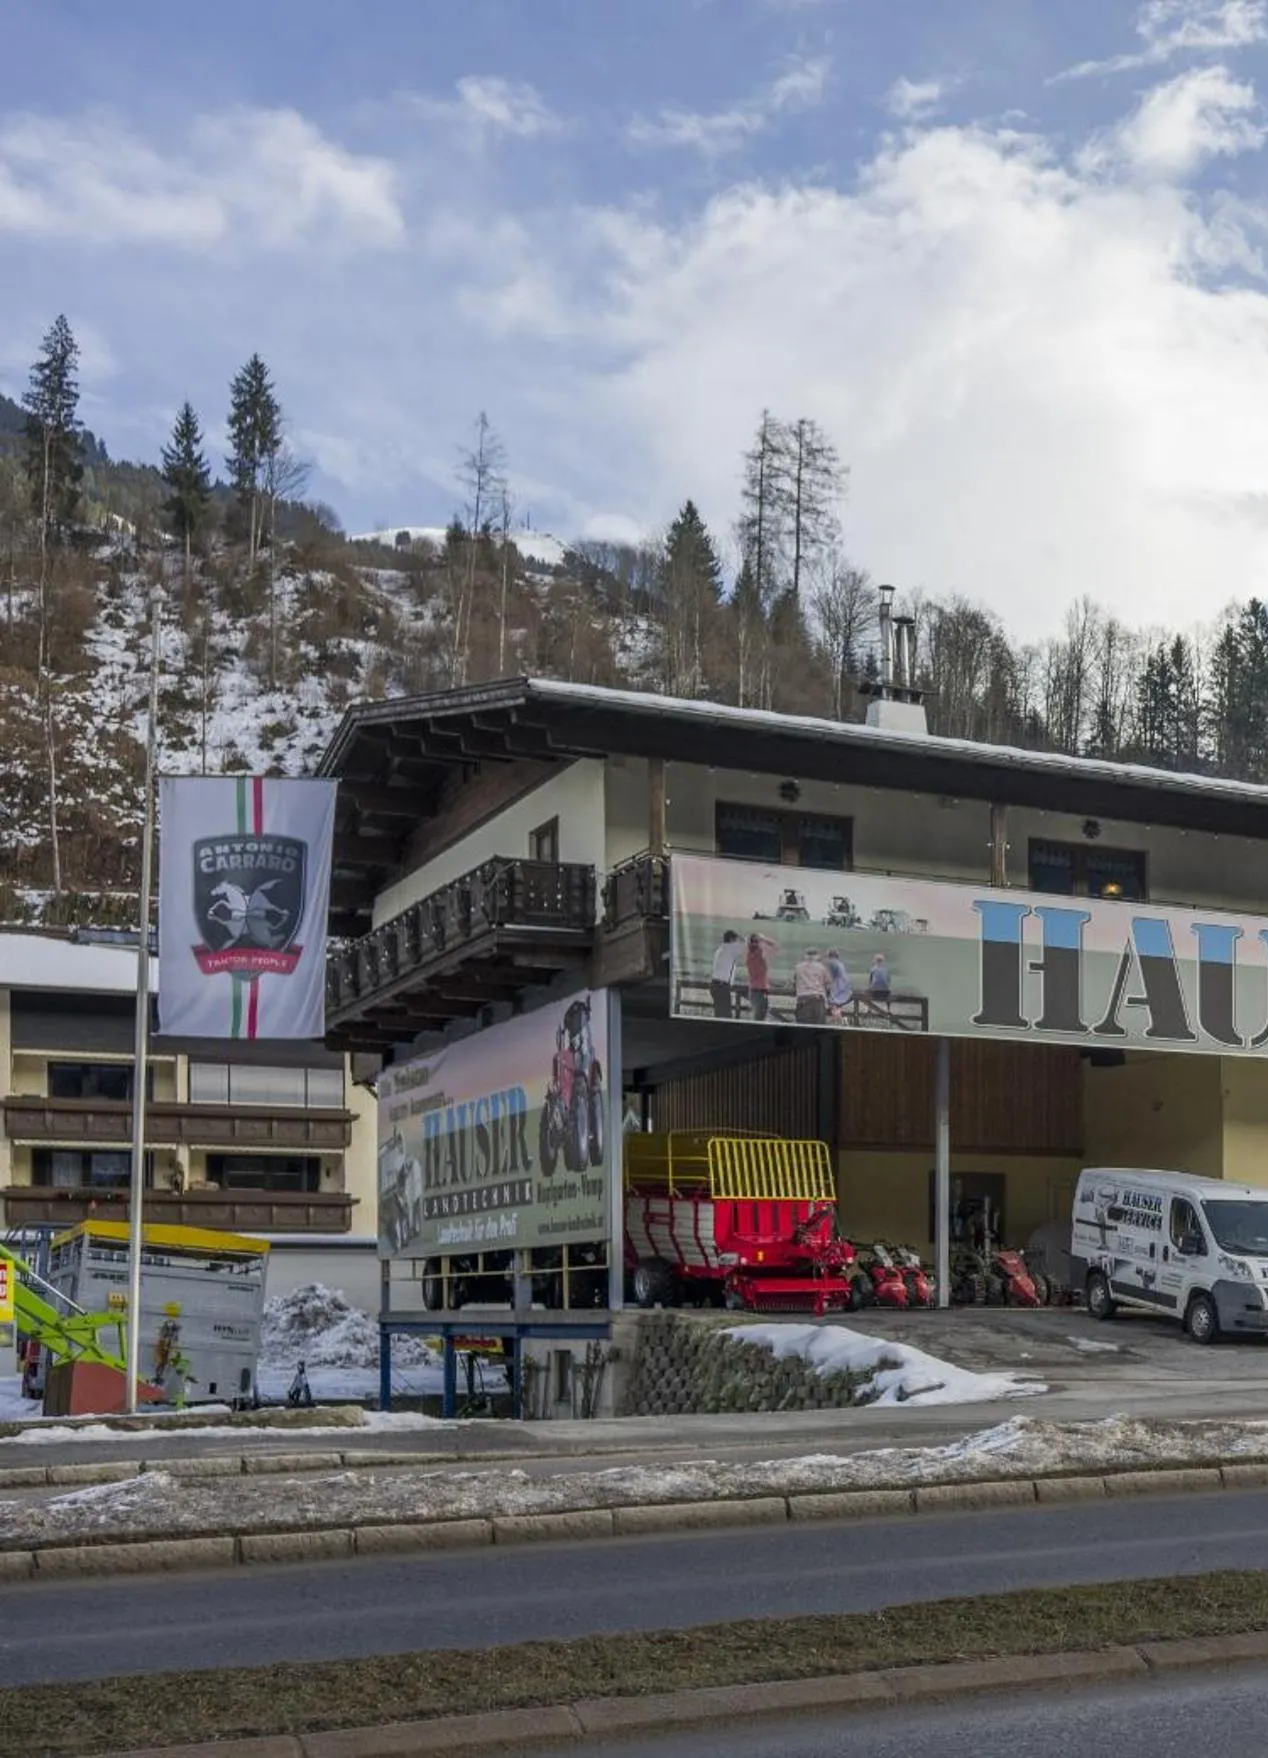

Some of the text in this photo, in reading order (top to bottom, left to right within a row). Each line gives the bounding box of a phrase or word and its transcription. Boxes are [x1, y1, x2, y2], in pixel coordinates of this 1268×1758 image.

[199, 842, 299, 858] ANTONIO
[200, 853, 296, 873] CARRARO
[422, 1083, 534, 1190] HAUSER
[422, 1179, 533, 1219] LANDTECHNIK
[1121, 1188, 1163, 1214] HAUSER
